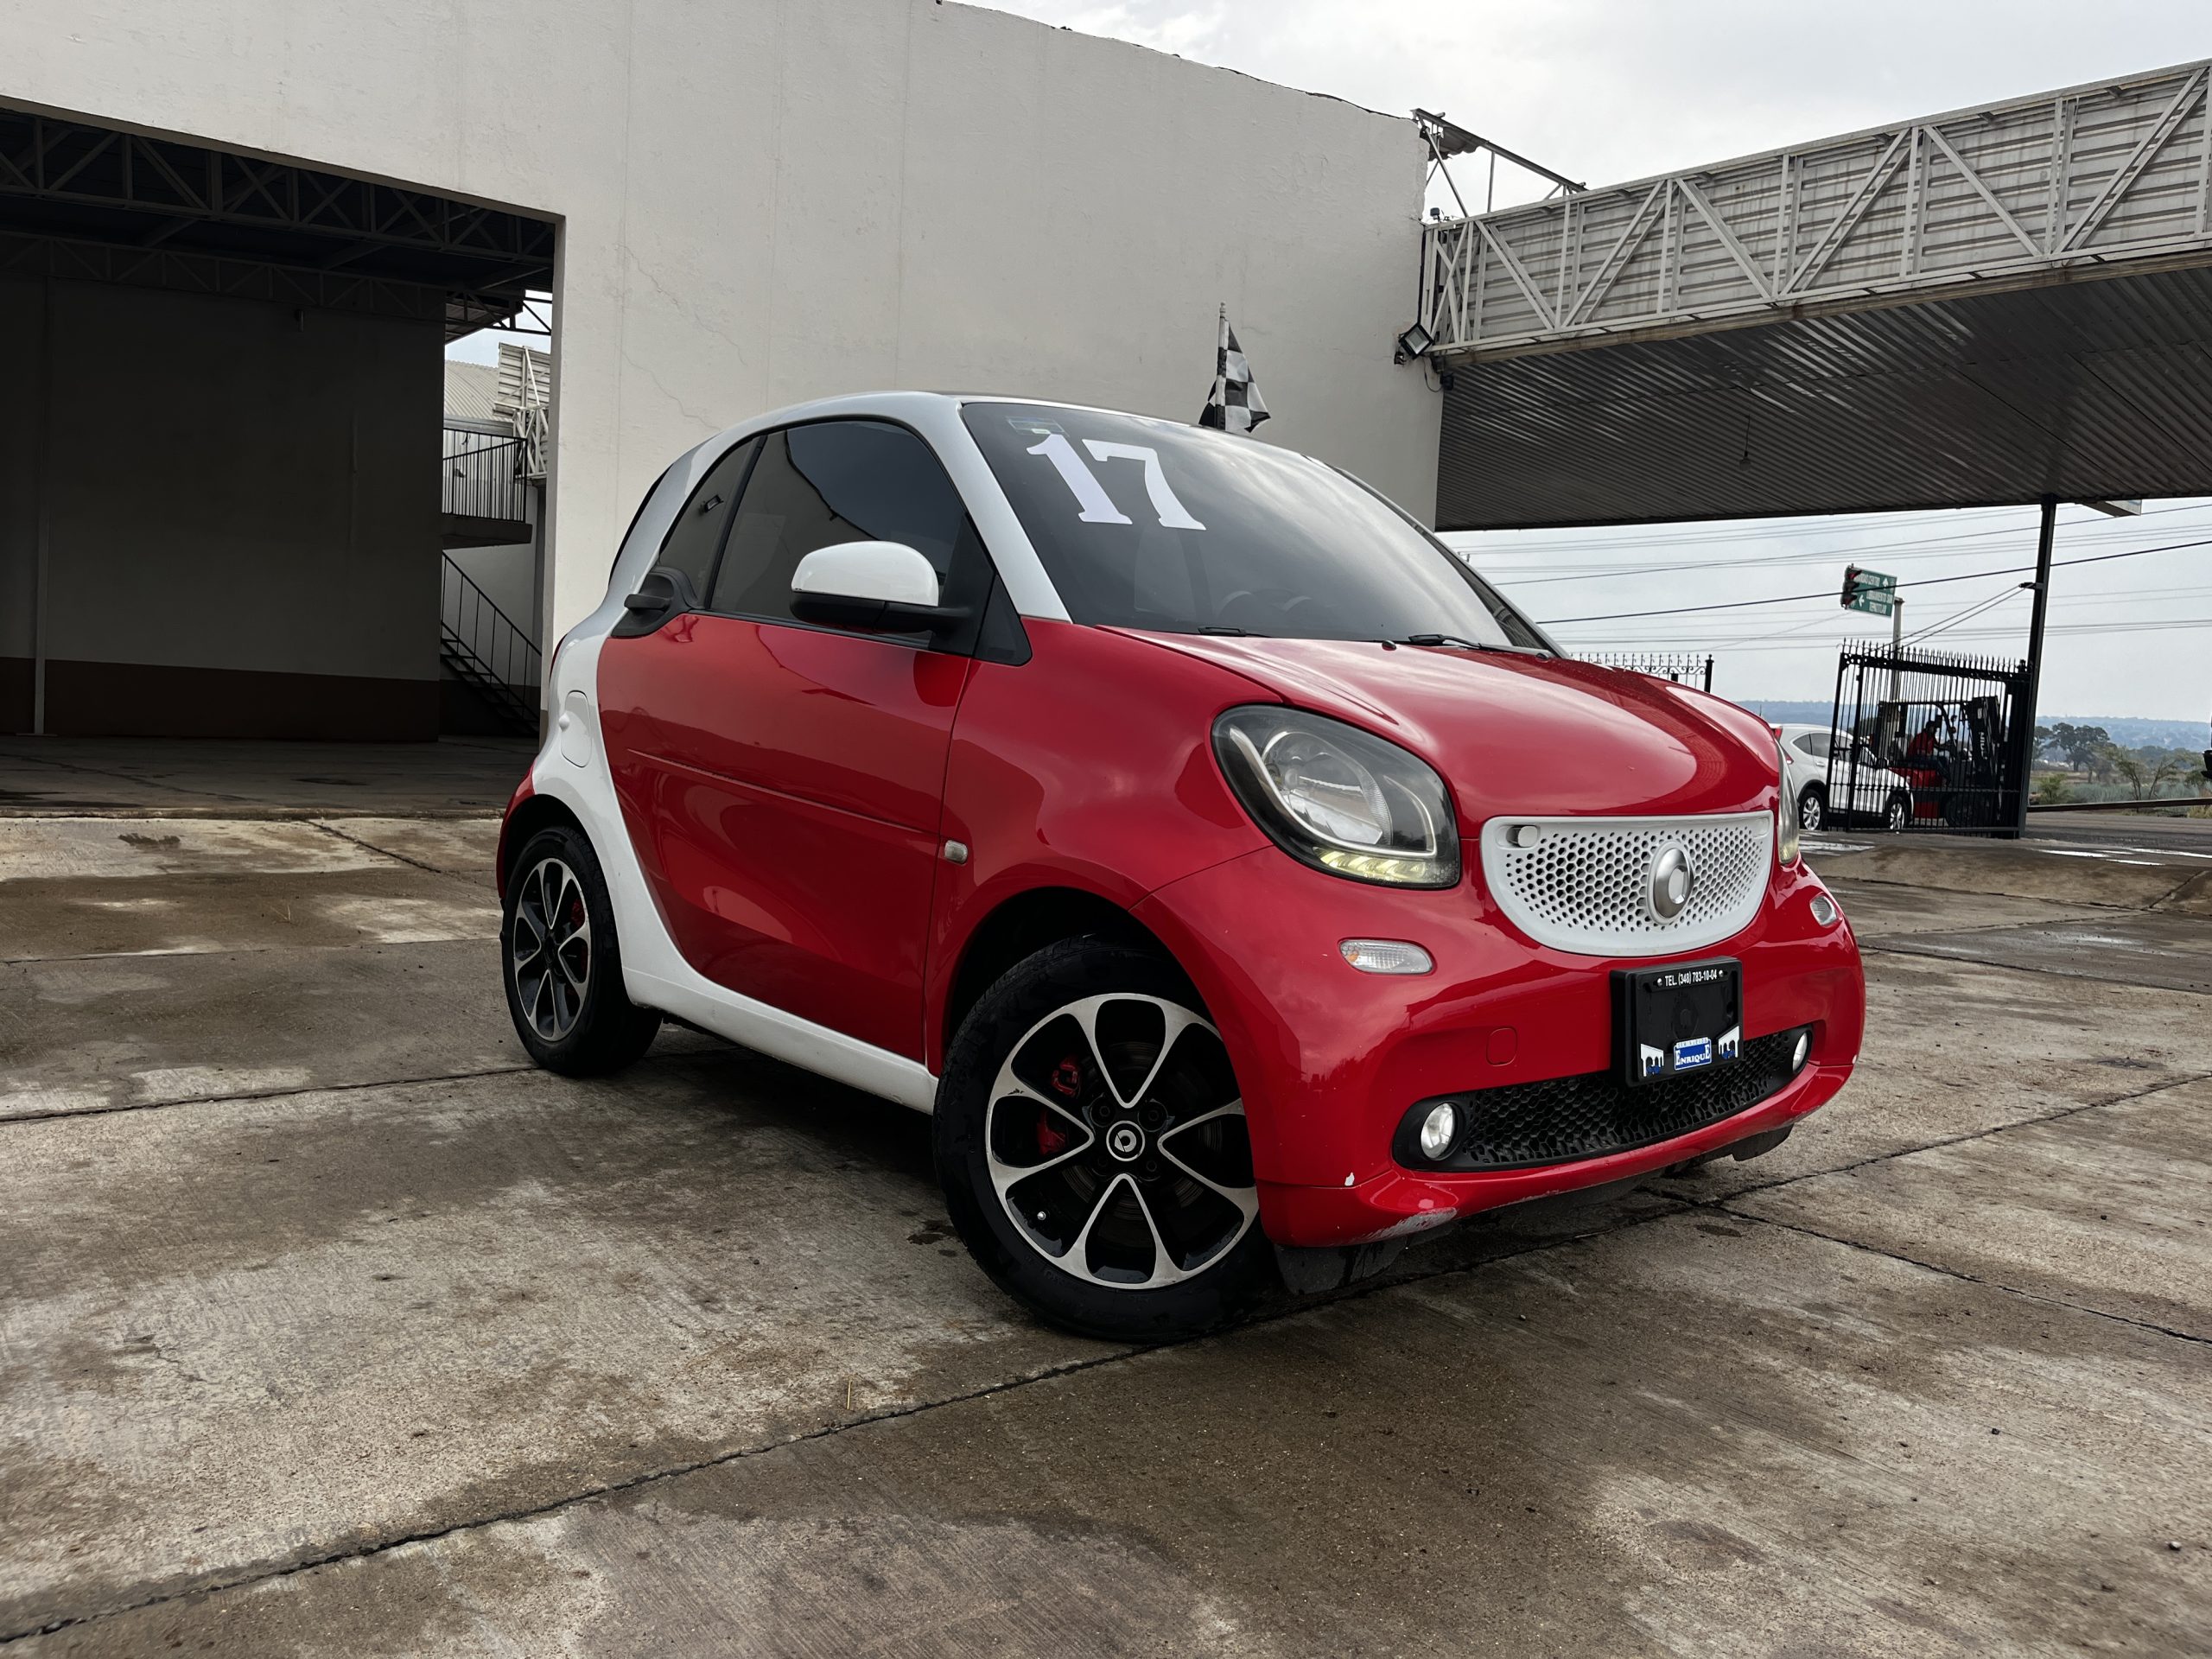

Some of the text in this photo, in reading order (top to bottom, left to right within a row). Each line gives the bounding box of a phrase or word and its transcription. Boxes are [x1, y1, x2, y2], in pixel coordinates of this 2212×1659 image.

[1026, 433, 1207, 531] 17
[1664, 975, 1677, 986] TEL.
[1678, 971, 1692, 985] (348)
